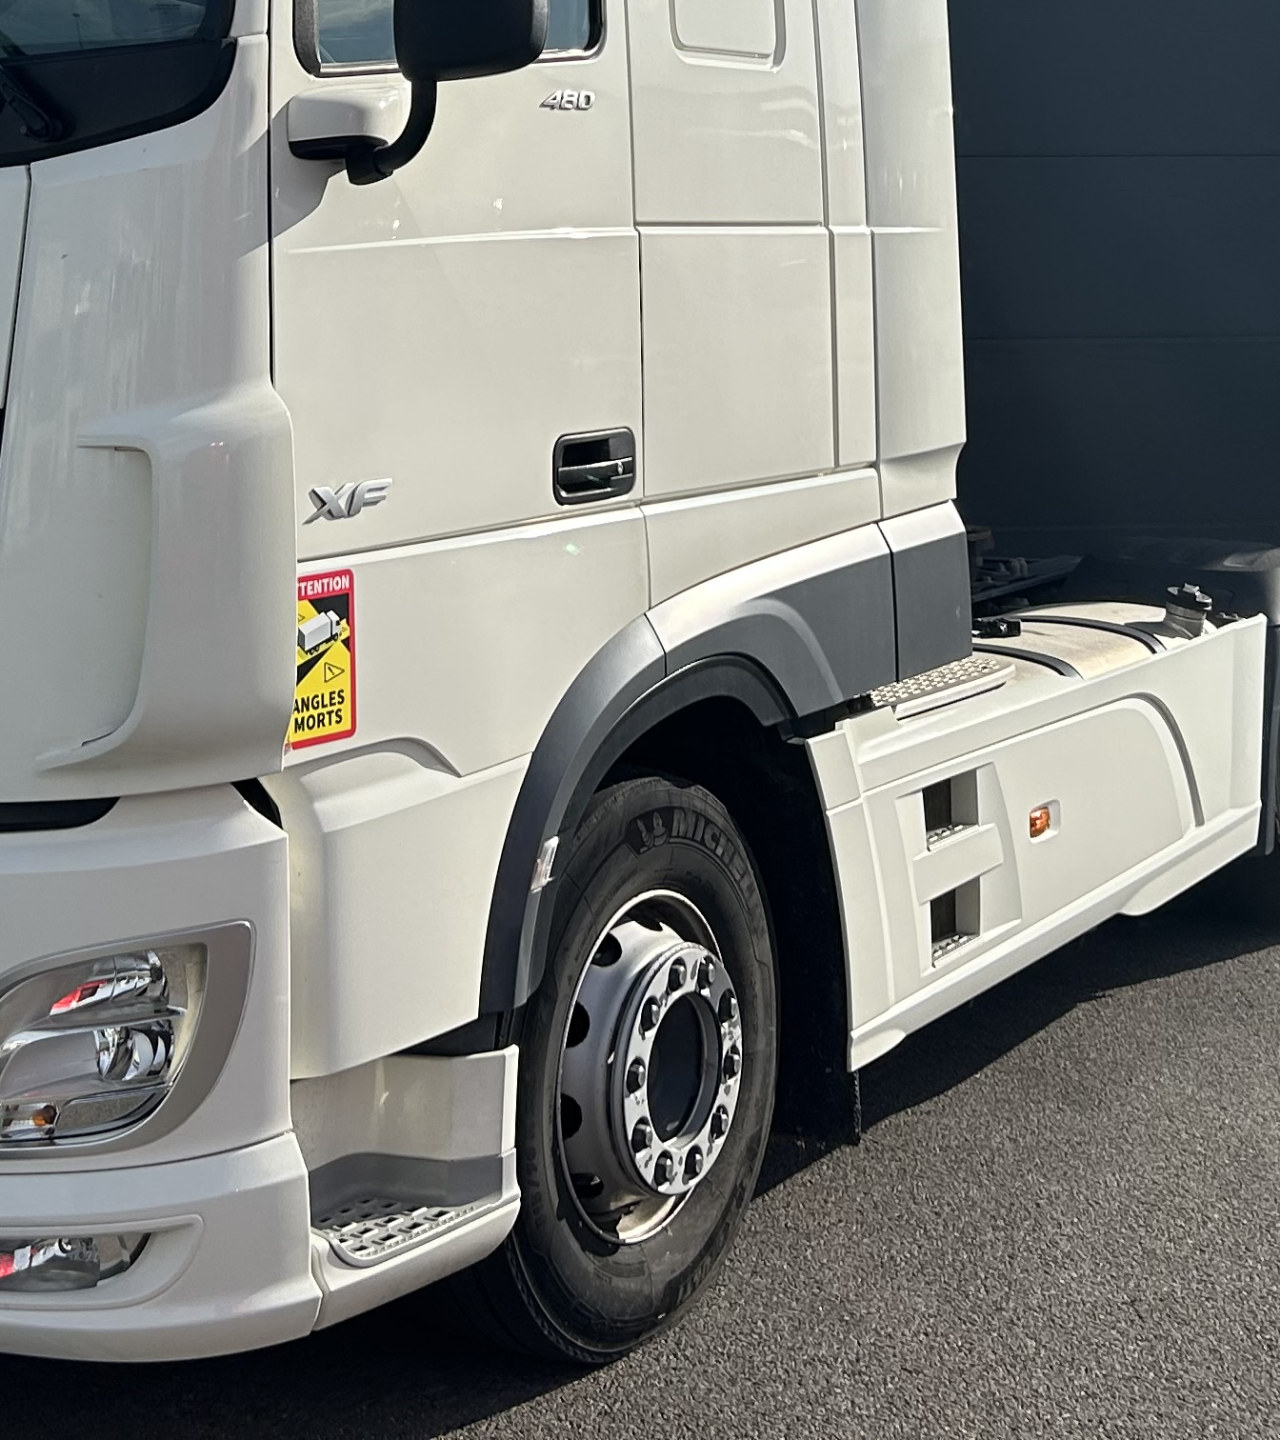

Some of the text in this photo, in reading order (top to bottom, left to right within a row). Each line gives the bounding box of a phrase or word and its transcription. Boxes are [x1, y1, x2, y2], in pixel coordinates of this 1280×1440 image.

[539, 89, 596, 111] 480
[302, 477, 393, 525] XF
[297, 574, 350, 597] TENTION
[292, 688, 345, 715] ANGLES
[294, 709, 343, 734] MORTS
